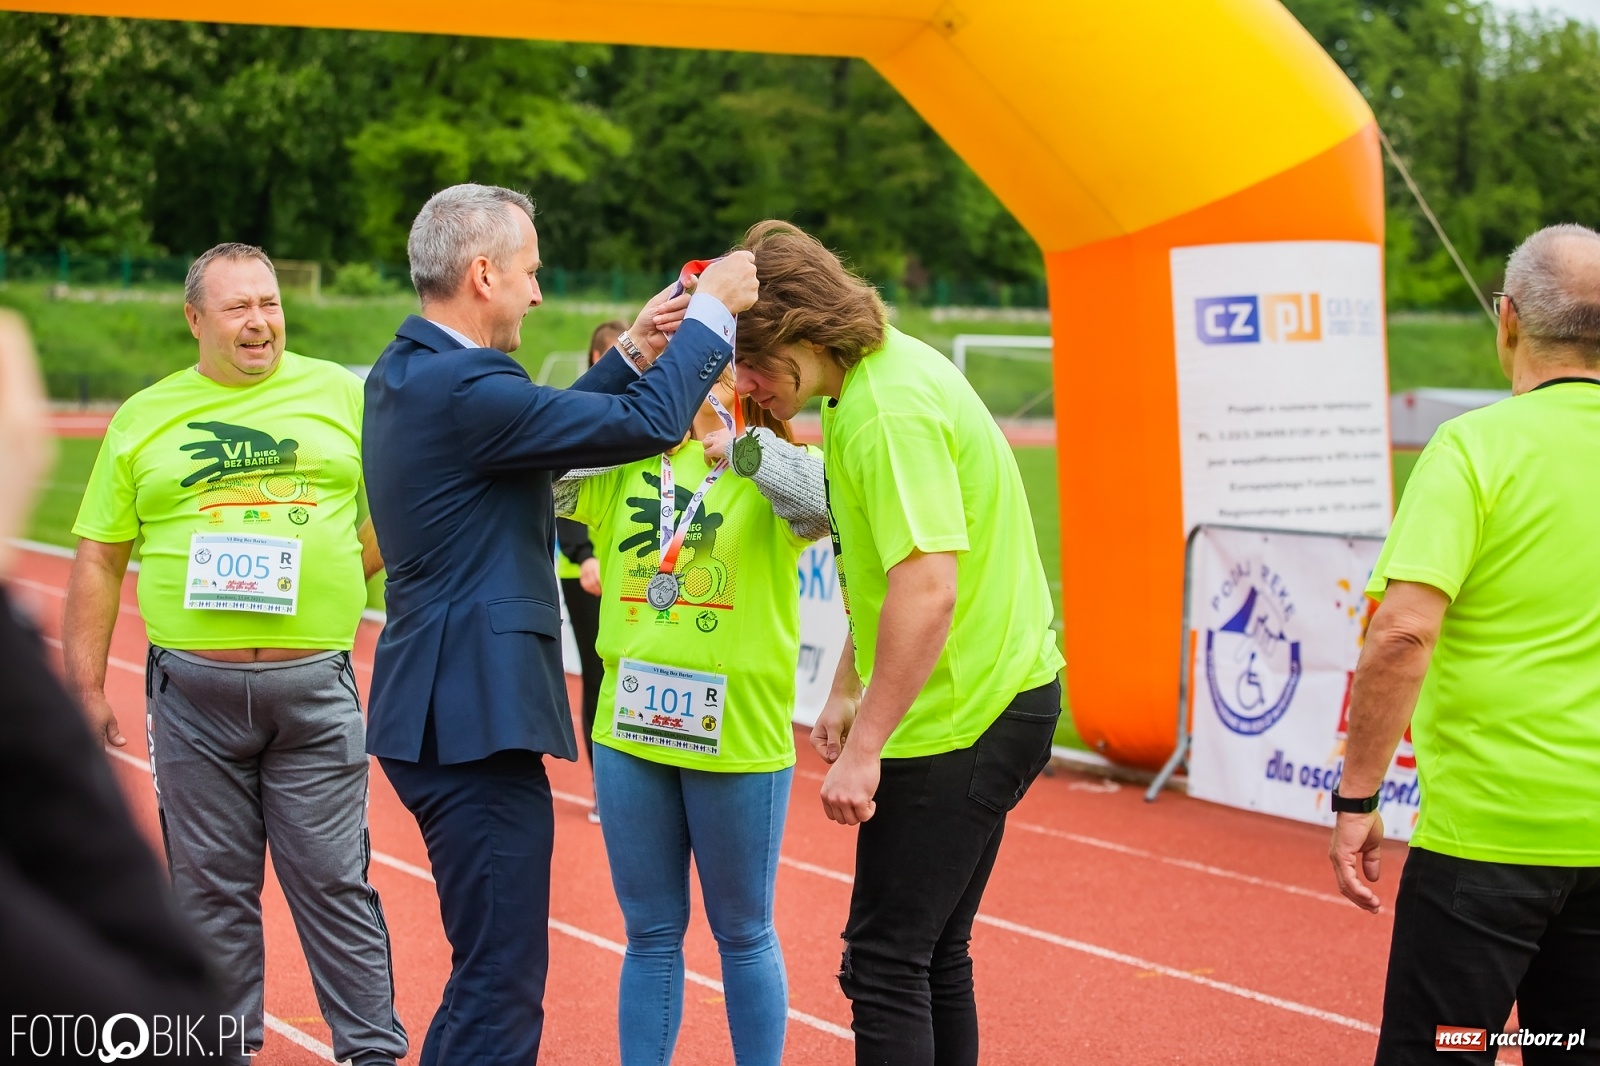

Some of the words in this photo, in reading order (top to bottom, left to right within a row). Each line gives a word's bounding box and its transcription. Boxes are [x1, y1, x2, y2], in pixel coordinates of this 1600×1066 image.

[222, 441, 252, 460] VI
[254, 449, 277, 458] BIEG
[223, 458, 243, 469] BEZ
[244, 456, 280, 467] BARIER
[684, 532, 702, 540] RIER
[216, 553, 270, 580] 005
[280, 551, 292, 565] R
[644, 685, 694, 718] 101
[705, 687, 718, 703] R
[1266, 750, 1294, 783] dla
